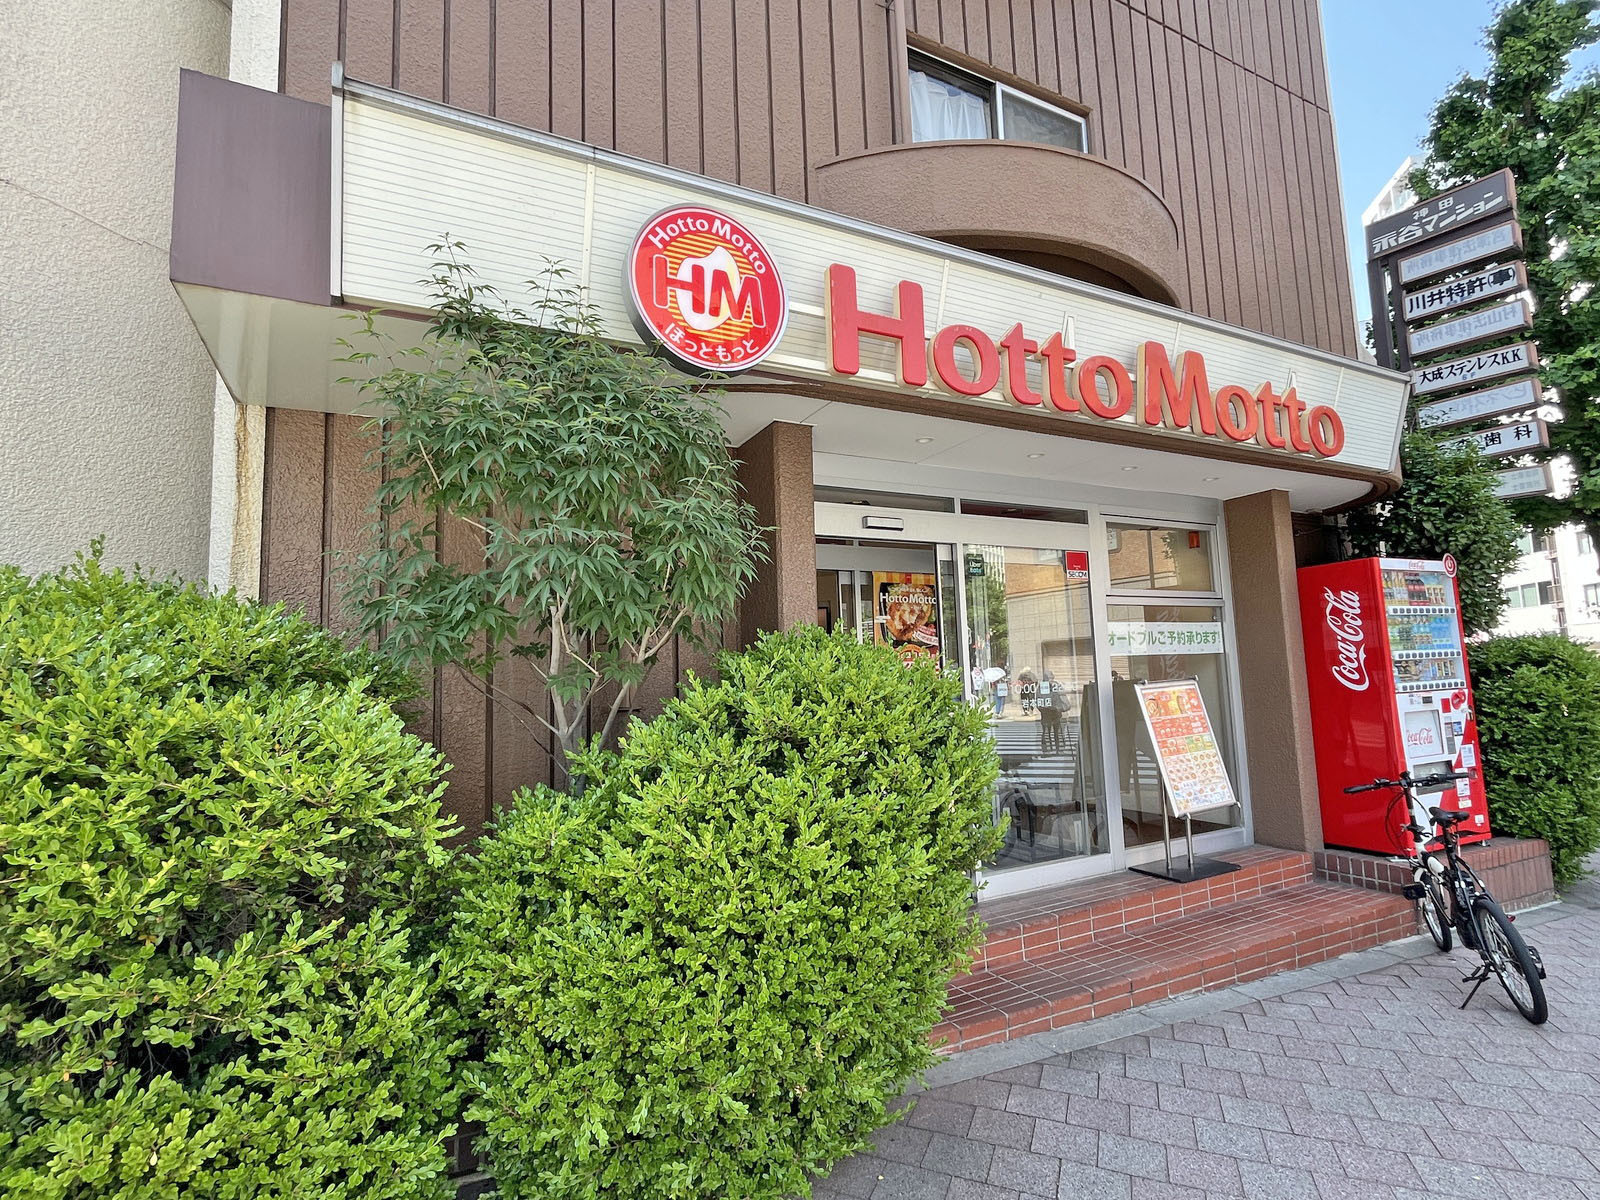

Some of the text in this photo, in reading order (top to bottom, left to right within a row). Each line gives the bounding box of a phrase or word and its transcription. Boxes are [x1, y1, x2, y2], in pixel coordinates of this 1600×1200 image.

[1412, 196, 1454, 220] 神田
[664, 322, 759, 362] ほっともっと
